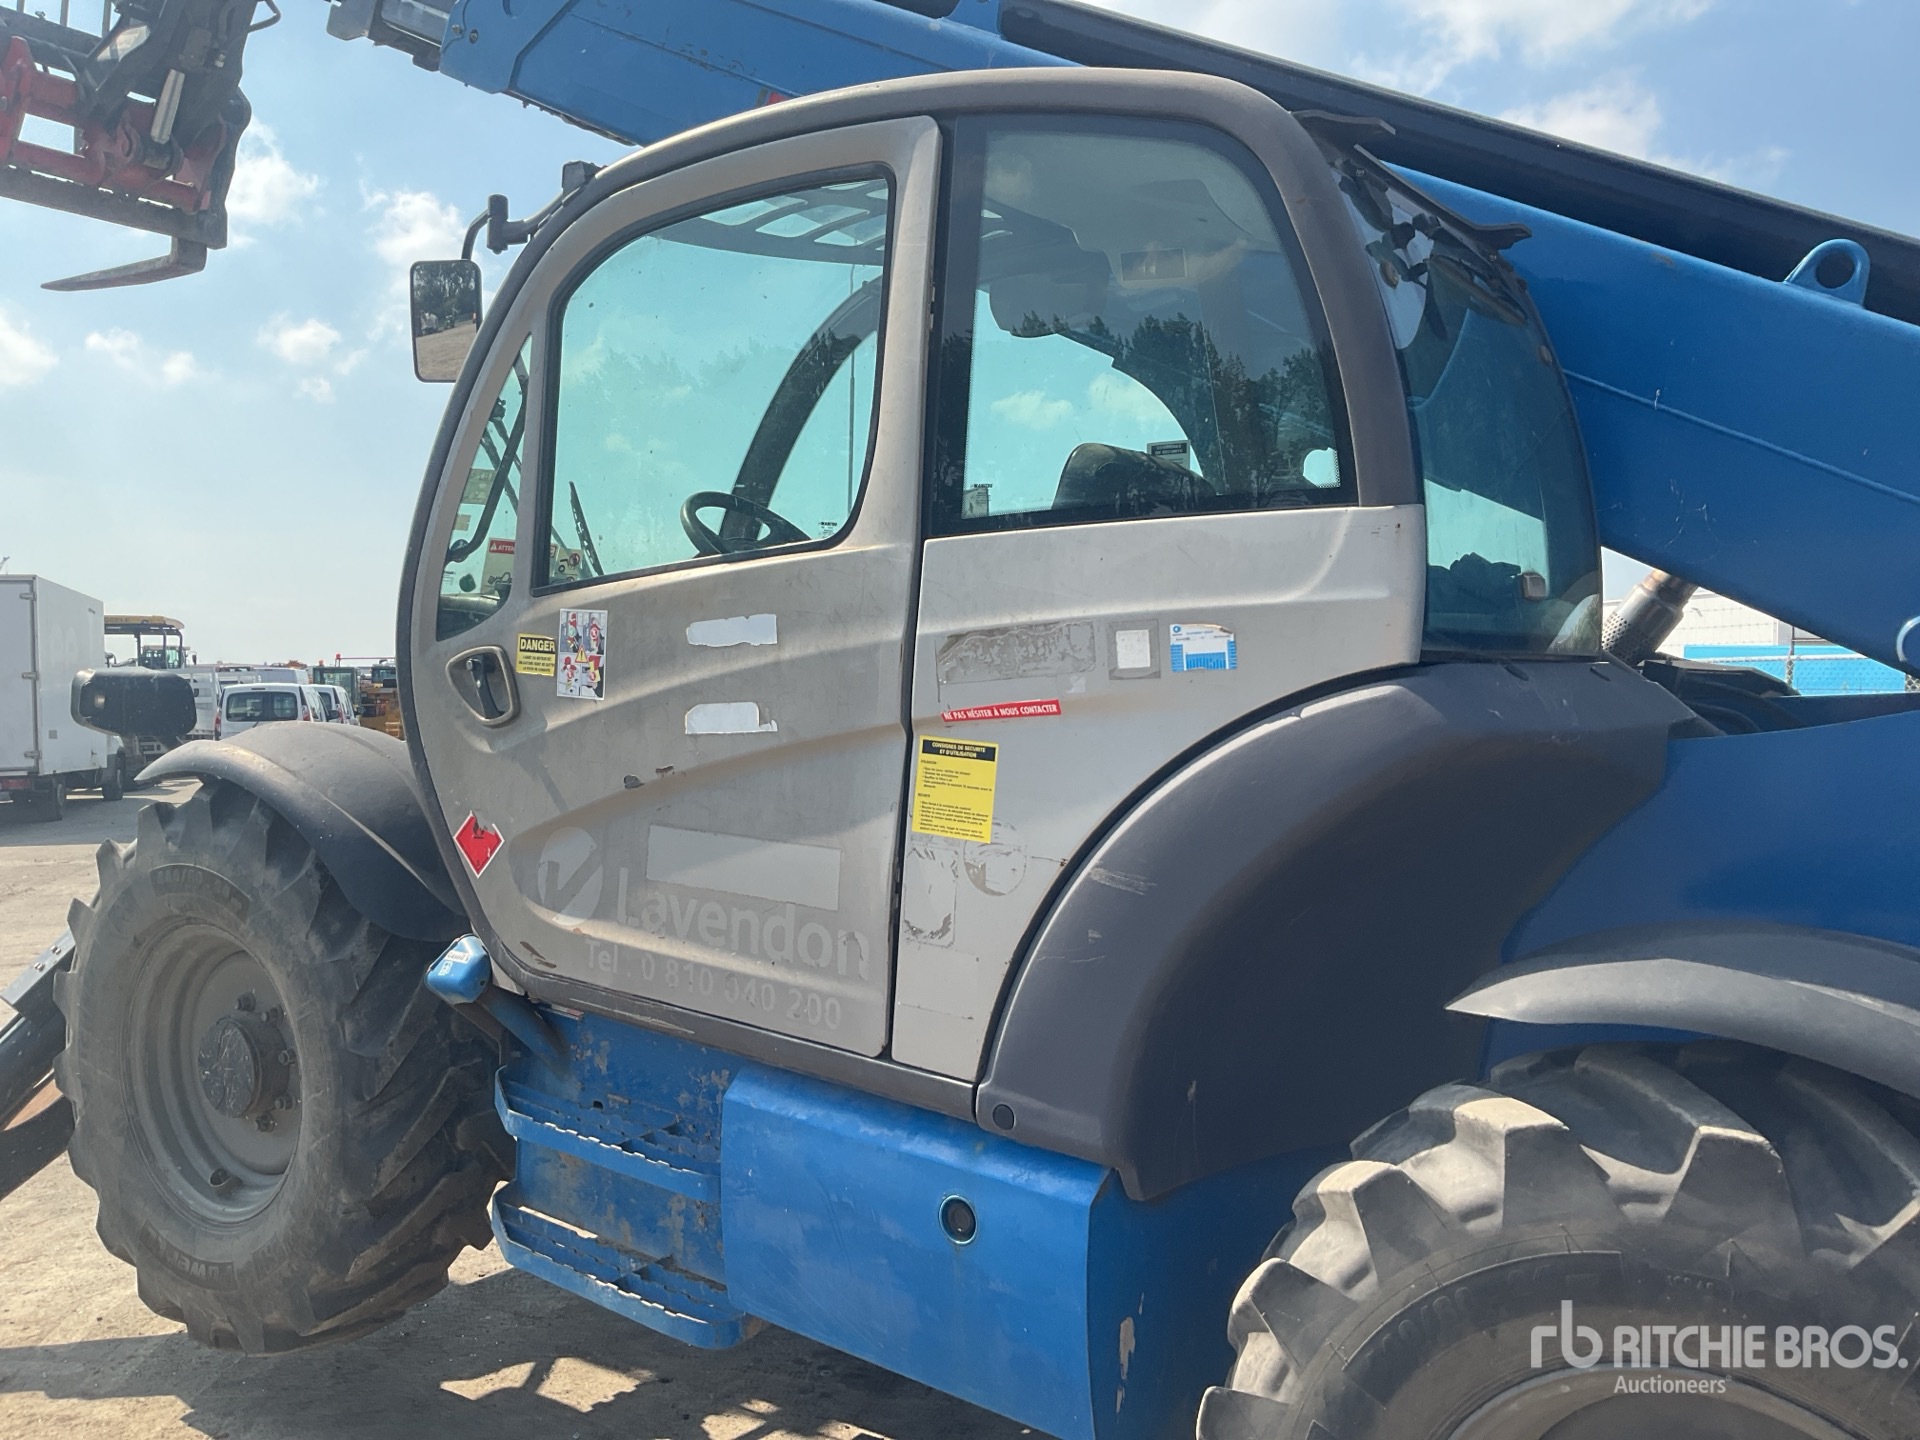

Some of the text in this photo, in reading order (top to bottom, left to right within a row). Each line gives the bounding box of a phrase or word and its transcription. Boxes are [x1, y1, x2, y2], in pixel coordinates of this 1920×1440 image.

[520, 638, 555, 652] DANGER
[943, 704, 1058, 720] NE PAS HÉSITER À NOUS CONTACTER
[931, 741, 957, 750] CONSIGNES
[617, 866, 870, 981] Lavendon
[584, 938, 618, 974] Tel
[665, 959, 714, 996] 810
[787, 987, 842, 1030] 200
